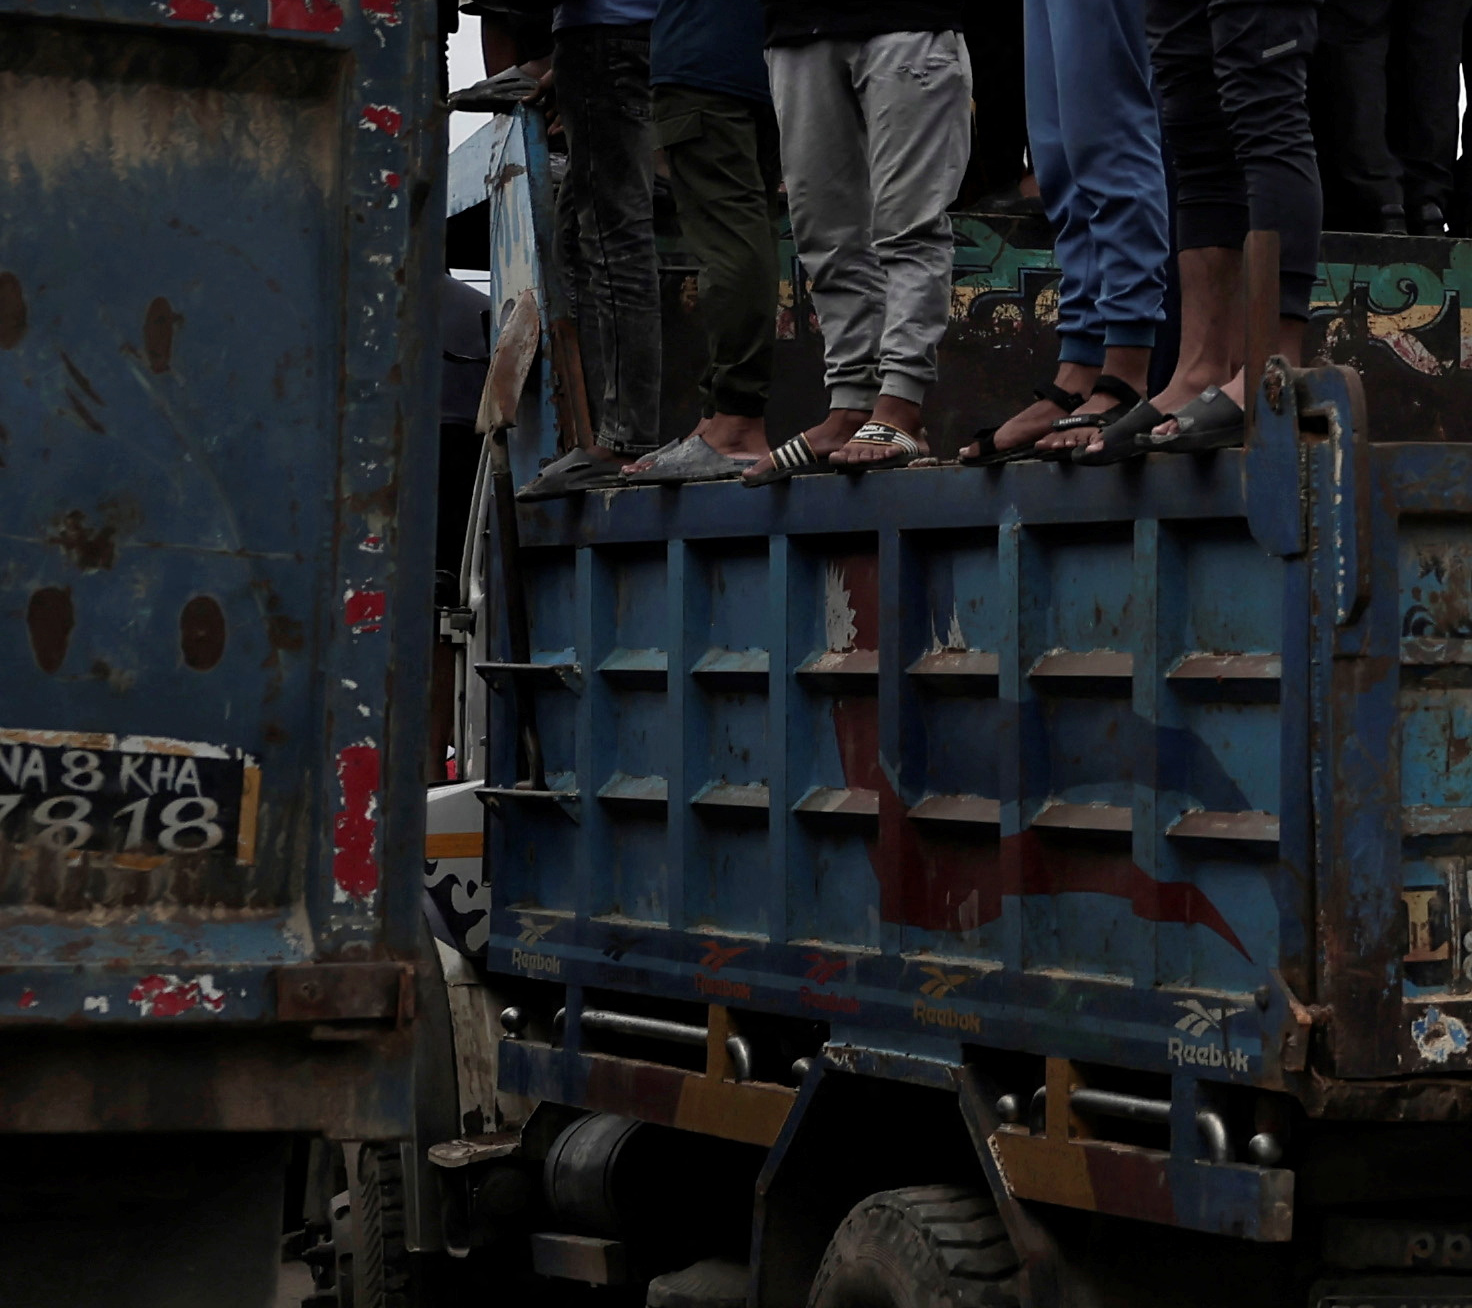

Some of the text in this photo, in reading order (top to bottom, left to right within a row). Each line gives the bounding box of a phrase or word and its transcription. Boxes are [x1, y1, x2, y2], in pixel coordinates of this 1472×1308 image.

[61, 750, 105, 792] 8
[120, 755, 201, 797] KHA
[913, 999, 982, 1034] Reebok
[1167, 1037, 1249, 1073] Reebok
